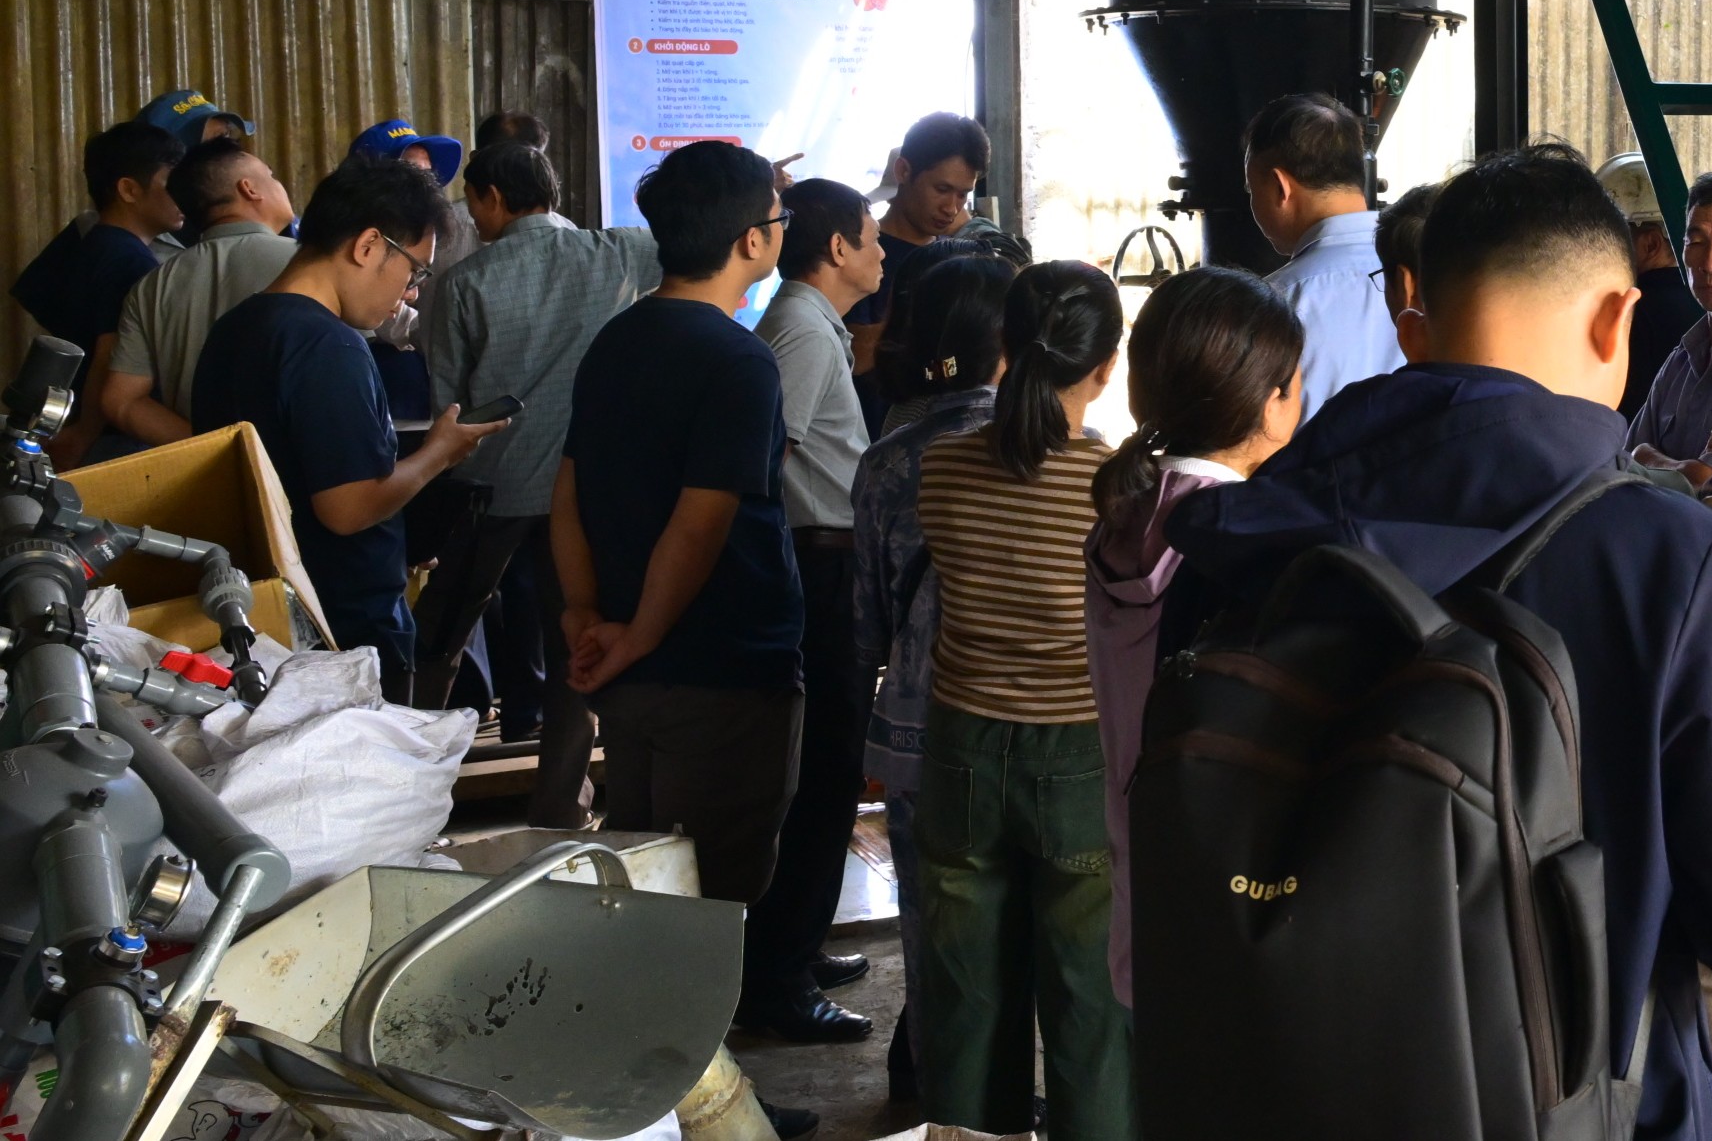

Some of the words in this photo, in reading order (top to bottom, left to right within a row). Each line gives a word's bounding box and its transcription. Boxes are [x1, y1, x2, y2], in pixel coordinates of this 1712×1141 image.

[654, 41, 674, 51] KHỞI
[676, 42, 698, 51] ĐỘNG
[700, 42, 710, 51] LÒ
[1230, 875, 1297, 901] GUBAG
